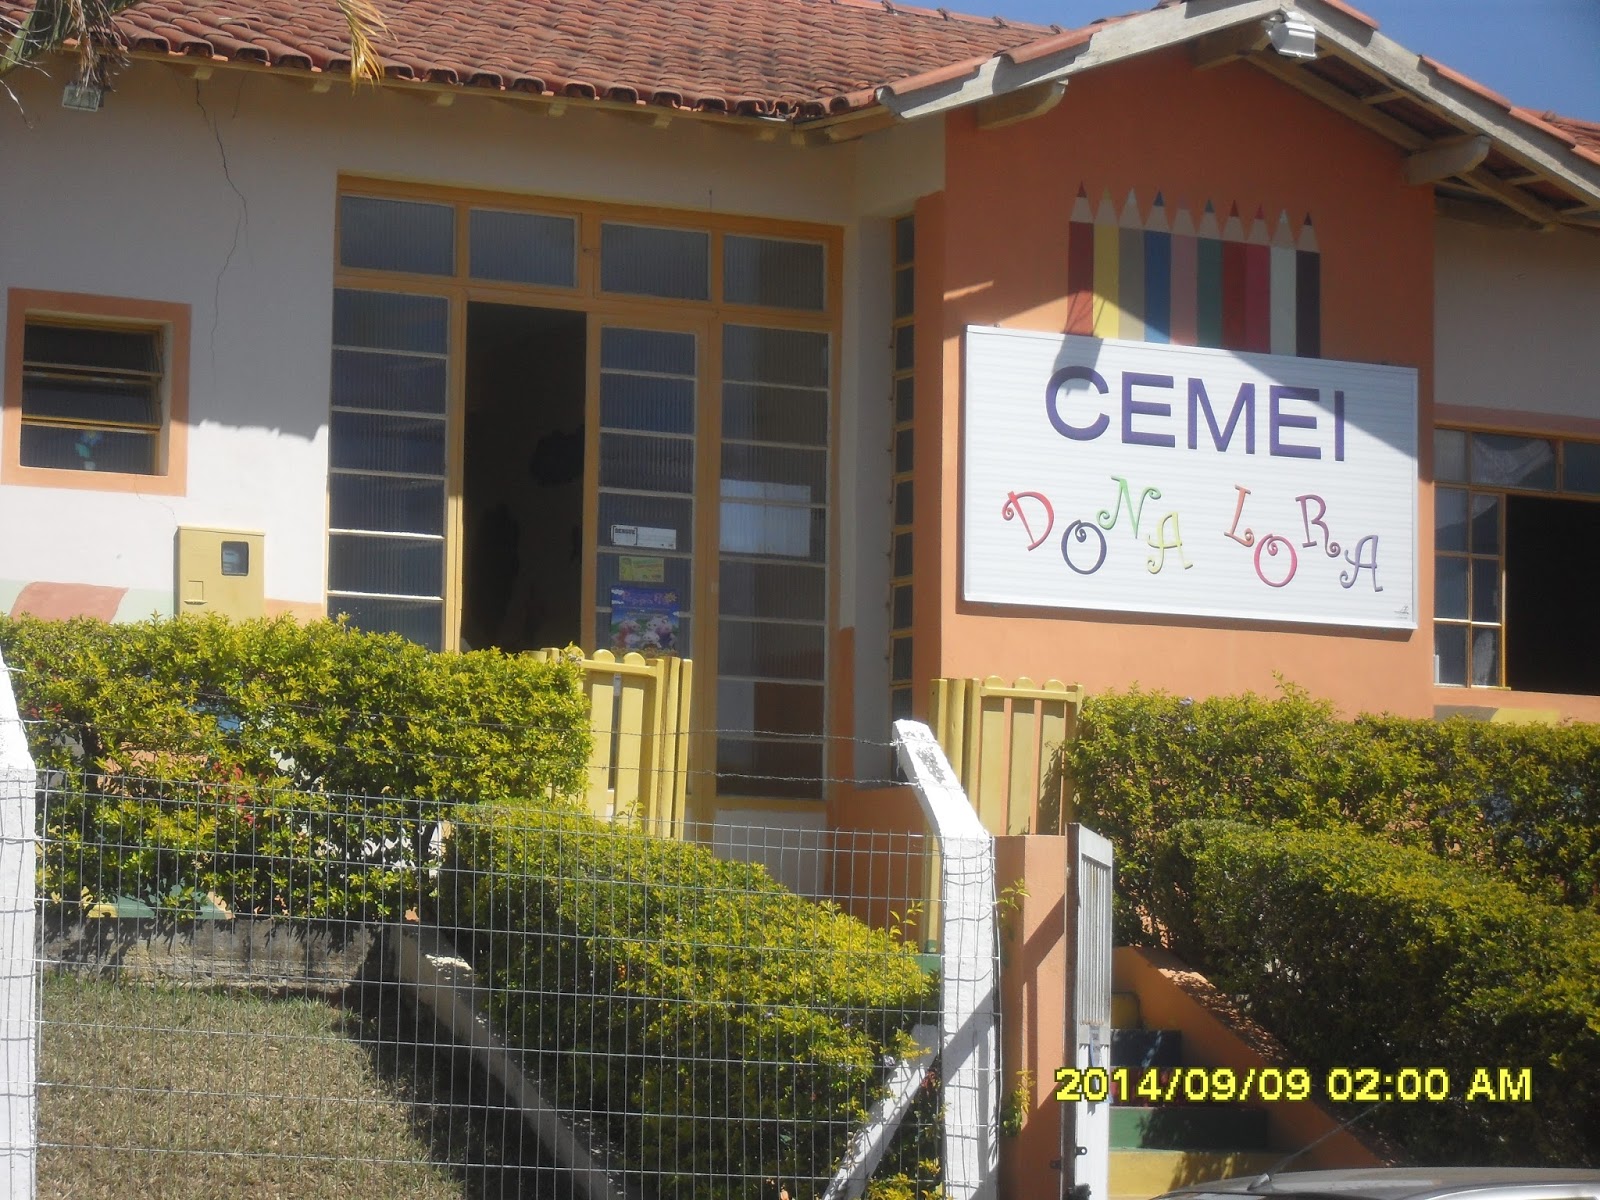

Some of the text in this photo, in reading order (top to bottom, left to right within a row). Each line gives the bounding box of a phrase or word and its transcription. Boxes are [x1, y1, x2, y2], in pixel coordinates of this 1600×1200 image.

[1046, 365, 1344, 461] CEMEI
[1001, 475, 1383, 592] DONA LORA
